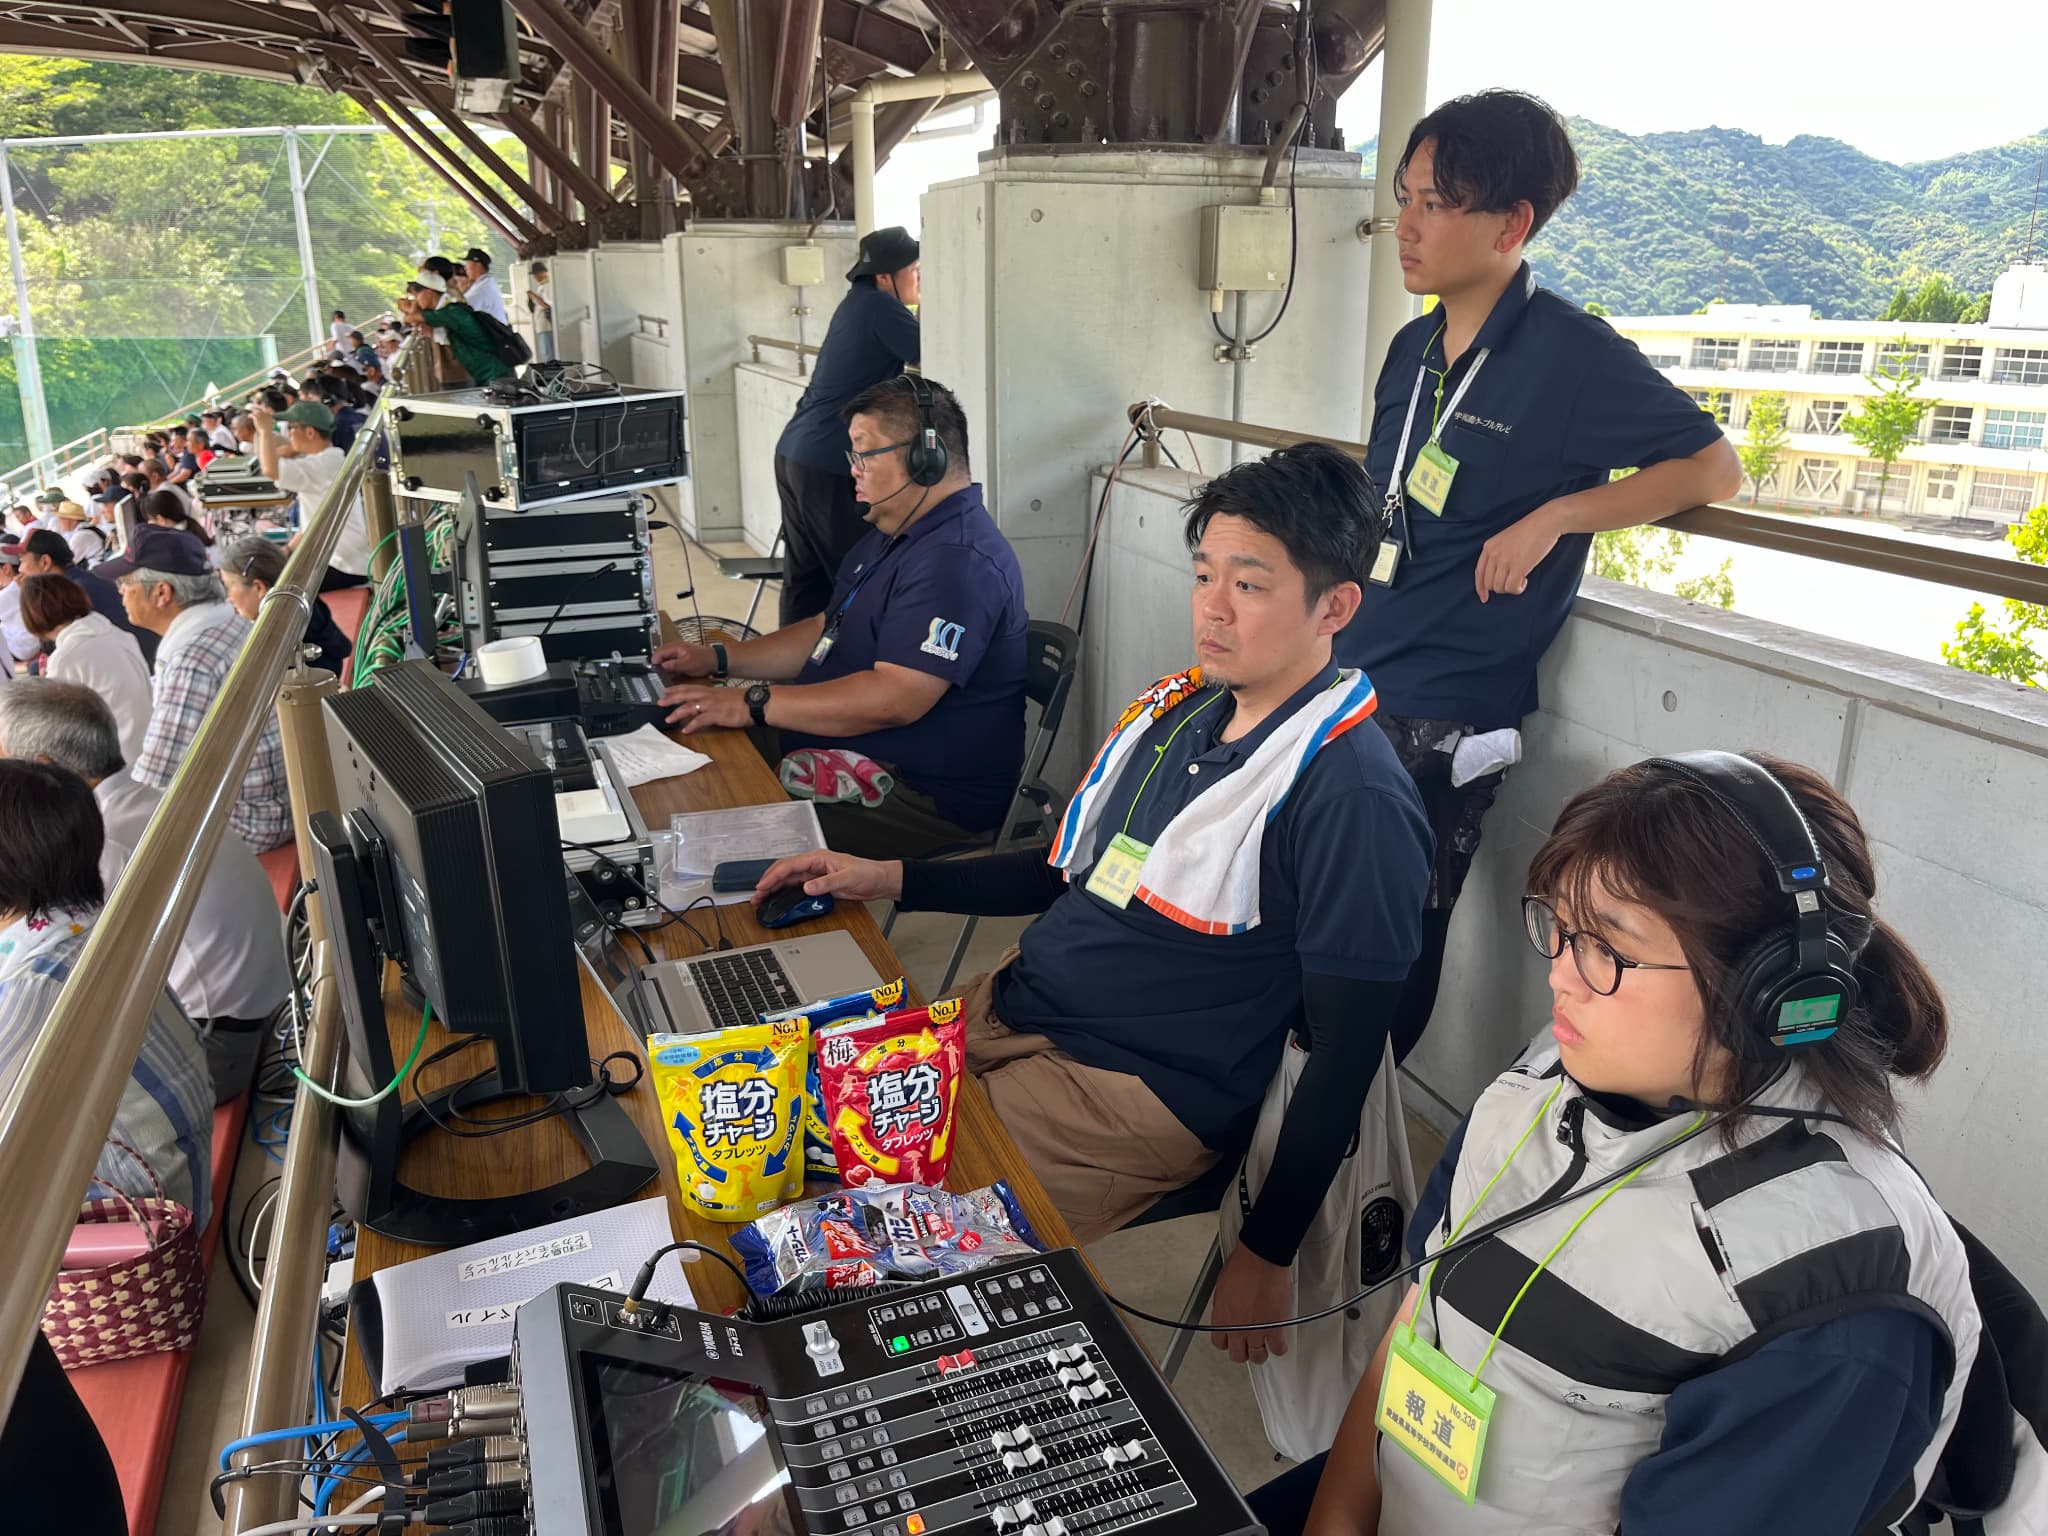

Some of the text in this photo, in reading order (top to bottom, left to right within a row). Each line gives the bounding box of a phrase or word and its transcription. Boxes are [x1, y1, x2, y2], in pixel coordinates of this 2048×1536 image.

[876, 980, 900, 999] No.1
[932, 1001, 957, 1017] No.1
[773, 1019, 800, 1035] No.1
[826, 1038, 855, 1066] 梅
[701, 1079, 776, 1121] 塩分
[869, 1064, 939, 1111] 塩分
[704, 1113, 777, 1147] チャージ
[873, 1098, 940, 1138] チャージ
[712, 1144, 767, 1160] タブレッツ
[882, 1128, 934, 1151] タブレッツ
[463, 1241, 587, 1281] 宇和島ケーブルテレビ
[698, 1322, 717, 1351] YAMAHA
[726, 1327, 743, 1357] DM3
[1405, 1388, 1456, 1449] 報道
[1450, 1402, 1477, 1432] No.338
